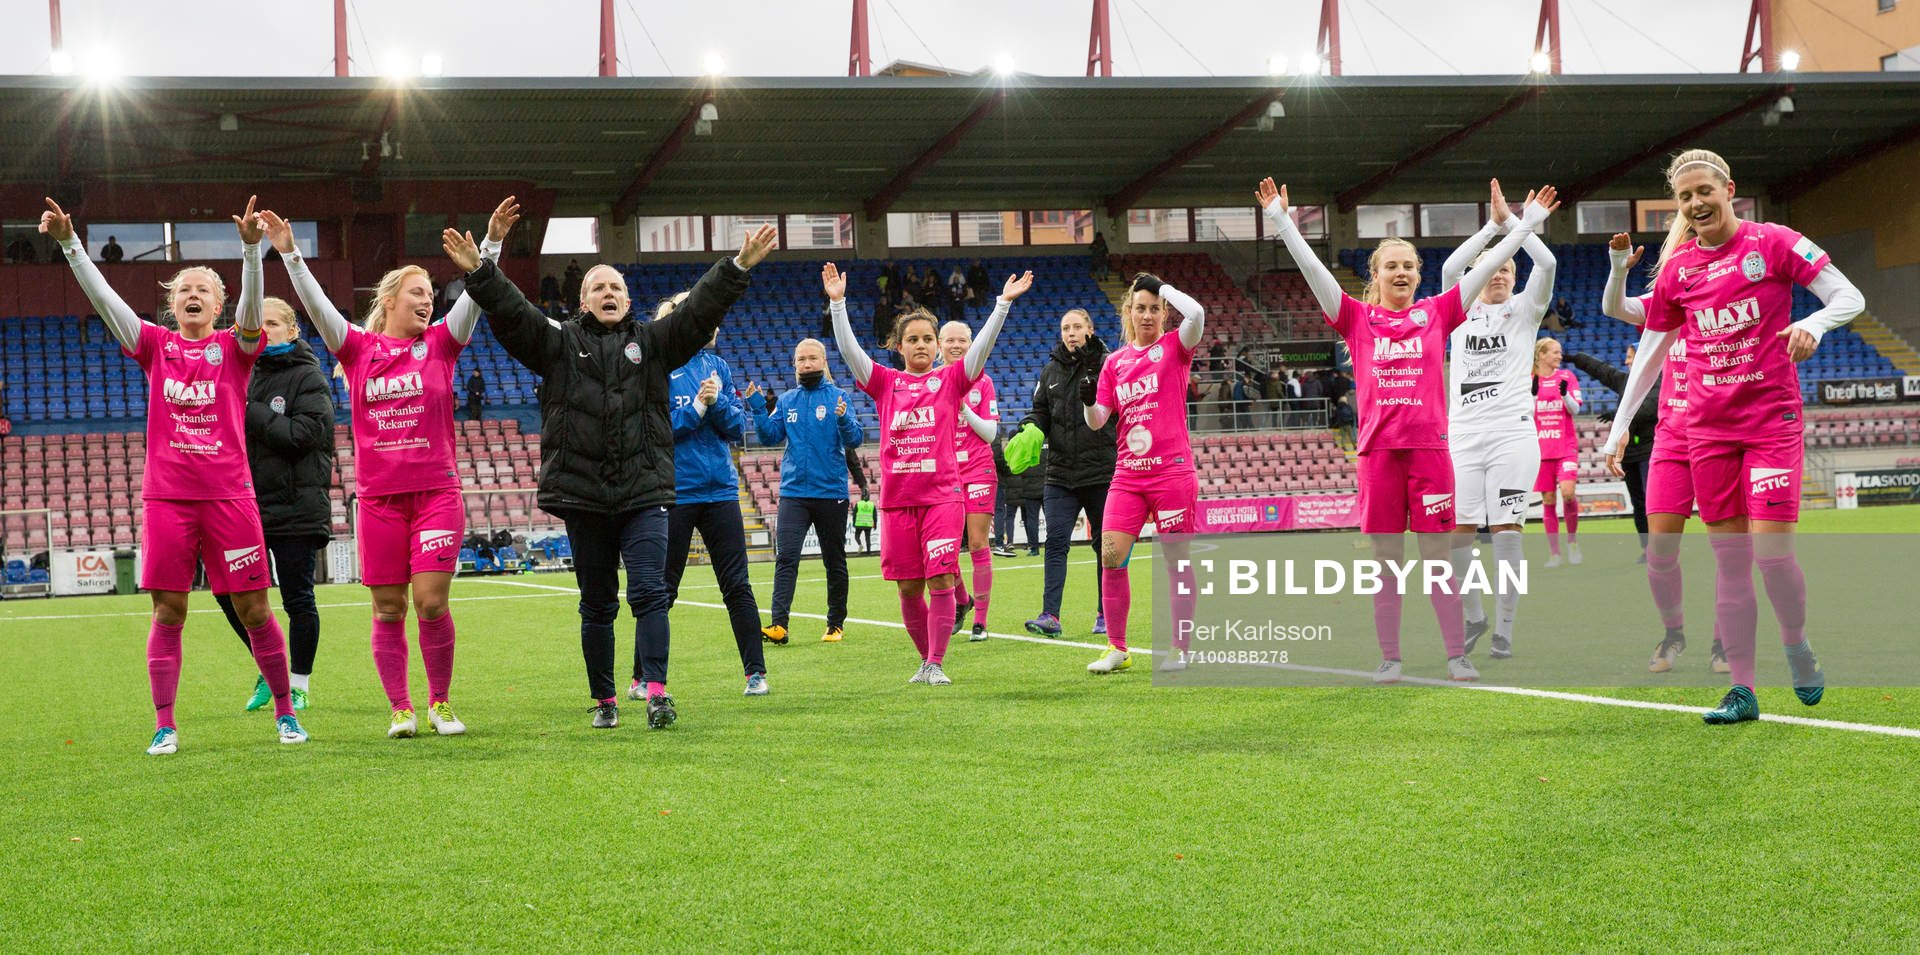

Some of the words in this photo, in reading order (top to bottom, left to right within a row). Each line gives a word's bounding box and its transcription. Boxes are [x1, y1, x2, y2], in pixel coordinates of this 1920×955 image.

[1707, 265, 1738, 282] stadium
[1694, 301, 1760, 332] MAXI
[1711, 319, 1760, 337] STORMARKNAD
[1373, 336, 1423, 355] MAXI
[1465, 334, 1507, 351] MAXI
[1701, 337, 1760, 356] Sparbanken
[1709, 352, 1755, 368] Rekarne
[1371, 366, 1423, 378] Sparbanken
[1716, 371, 1765, 385] BARKMANS
[163, 378, 216, 401] MAXI
[366, 374, 423, 397] MAXI
[1115, 374, 1159, 401] MAXI
[1378, 378, 1416, 388] Rekarne
[1857, 382, 1875, 399] the
[377, 389, 423, 401] STORMARKNAD
[674, 395, 691, 409] 32
[1376, 397, 1423, 406] MAGNOLIA
[1462, 388, 1499, 408] ACTIC
[368, 404, 425, 421] Sparbanken
[786, 412, 798, 423] 20
[891, 406, 936, 428] MAXI
[378, 418, 418, 431] Rekarne
[889, 434, 936, 448] Sparbanken
[897, 446, 930, 456] Rekarne
[1123, 456, 1163, 467] SPORTIVE
[1752, 476, 1790, 495] ACTIC
[969, 488, 990, 500] ACTIC
[1500, 495, 1524, 508] ACTIC
[1207, 507, 1236, 516] COMFORT
[1425, 499, 1452, 517] ACTIC
[1160, 515, 1184, 530] ACTIC
[1206, 512, 1259, 526] ESKILSTUNA
[421, 536, 454, 553] ACTIC
[929, 543, 955, 561] ACTIC
[76, 555, 109, 571] ICA
[229, 551, 261, 573] ACTIC
[77, 579, 111, 587] Safiren
